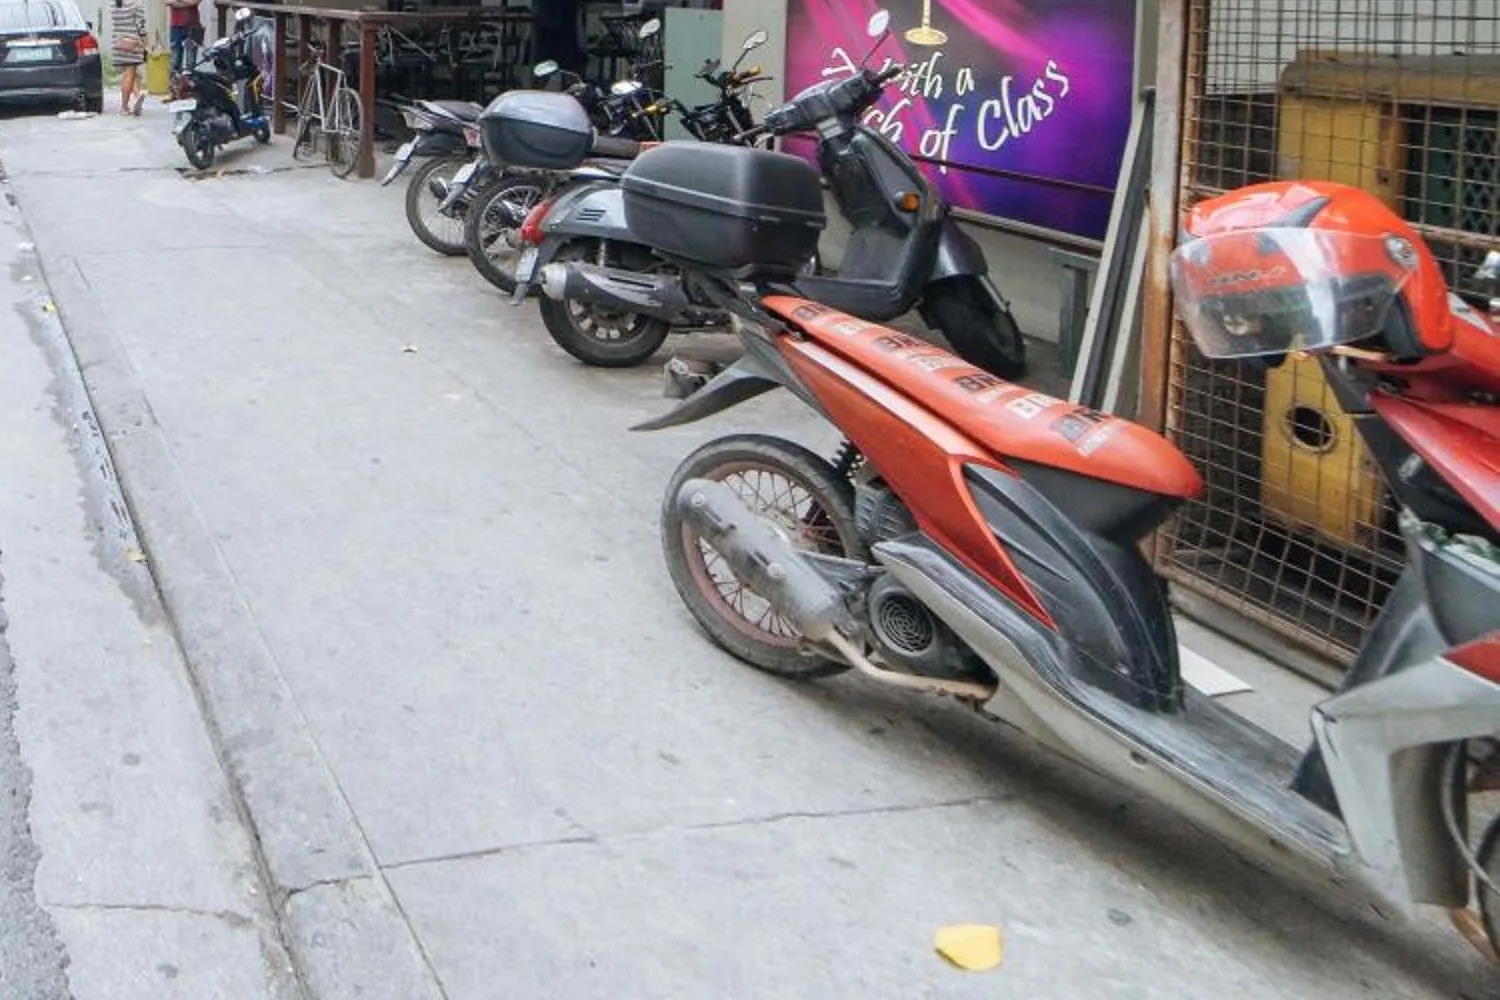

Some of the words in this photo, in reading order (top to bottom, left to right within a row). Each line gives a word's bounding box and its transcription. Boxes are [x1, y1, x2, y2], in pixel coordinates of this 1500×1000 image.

[919, 103, 965, 175] of
[977, 59, 1070, 151] Class
[956, 67, 975, 96] a
